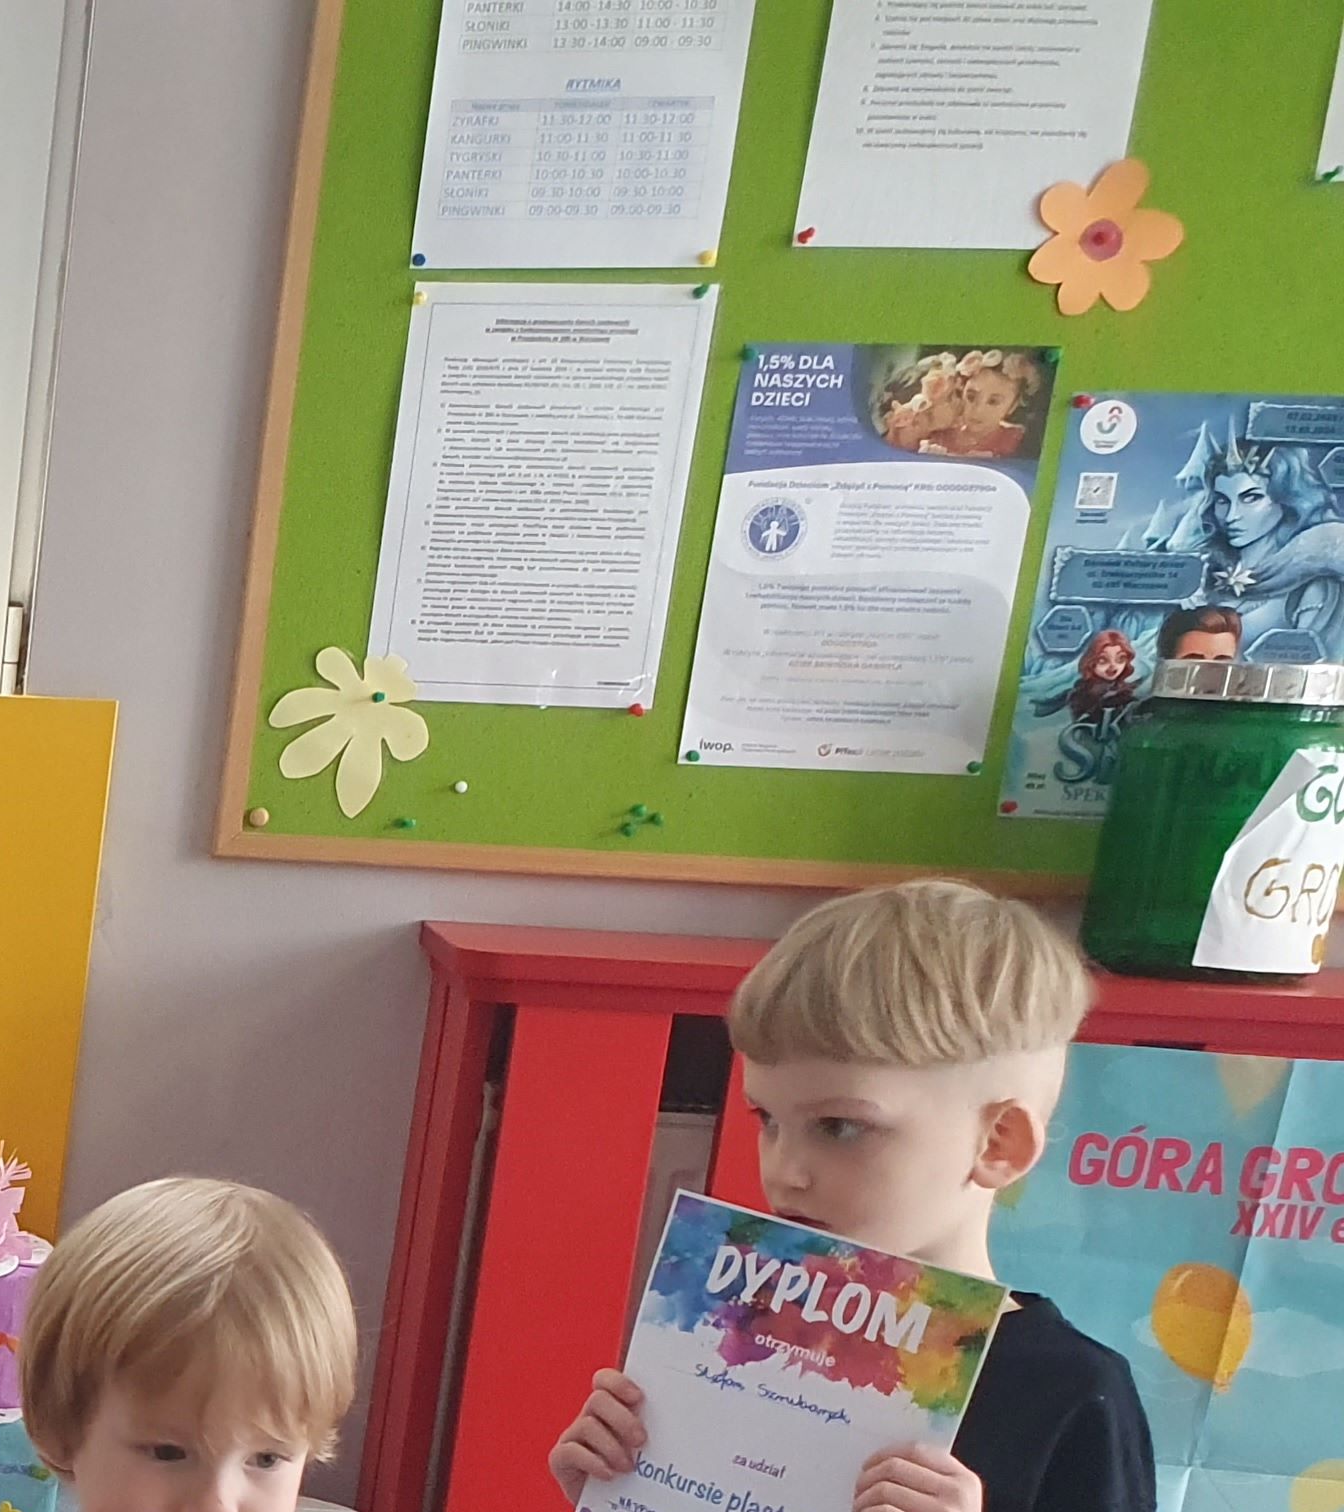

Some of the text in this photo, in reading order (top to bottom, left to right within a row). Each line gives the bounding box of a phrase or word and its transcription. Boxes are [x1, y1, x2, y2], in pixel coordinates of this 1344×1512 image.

[462, 38, 528, 50] PINGWINKI
[565, 78, 623, 92] RYTMIKA
[757, 355, 835, 370] 1,5% DLA
[754, 374, 844, 389] NASZYCH
[750, 391, 812, 407] DZIECI
[1068, 1124, 1224, 1196] GÓRA
[1229, 1199, 1326, 1241] XXIV
[706, 1244, 933, 1354] DYPLOM
[754, 1332, 837, 1369] otrzymuje
[632, 1450, 724, 1506] konkursie
[732, 1452, 787, 1480] za udział
